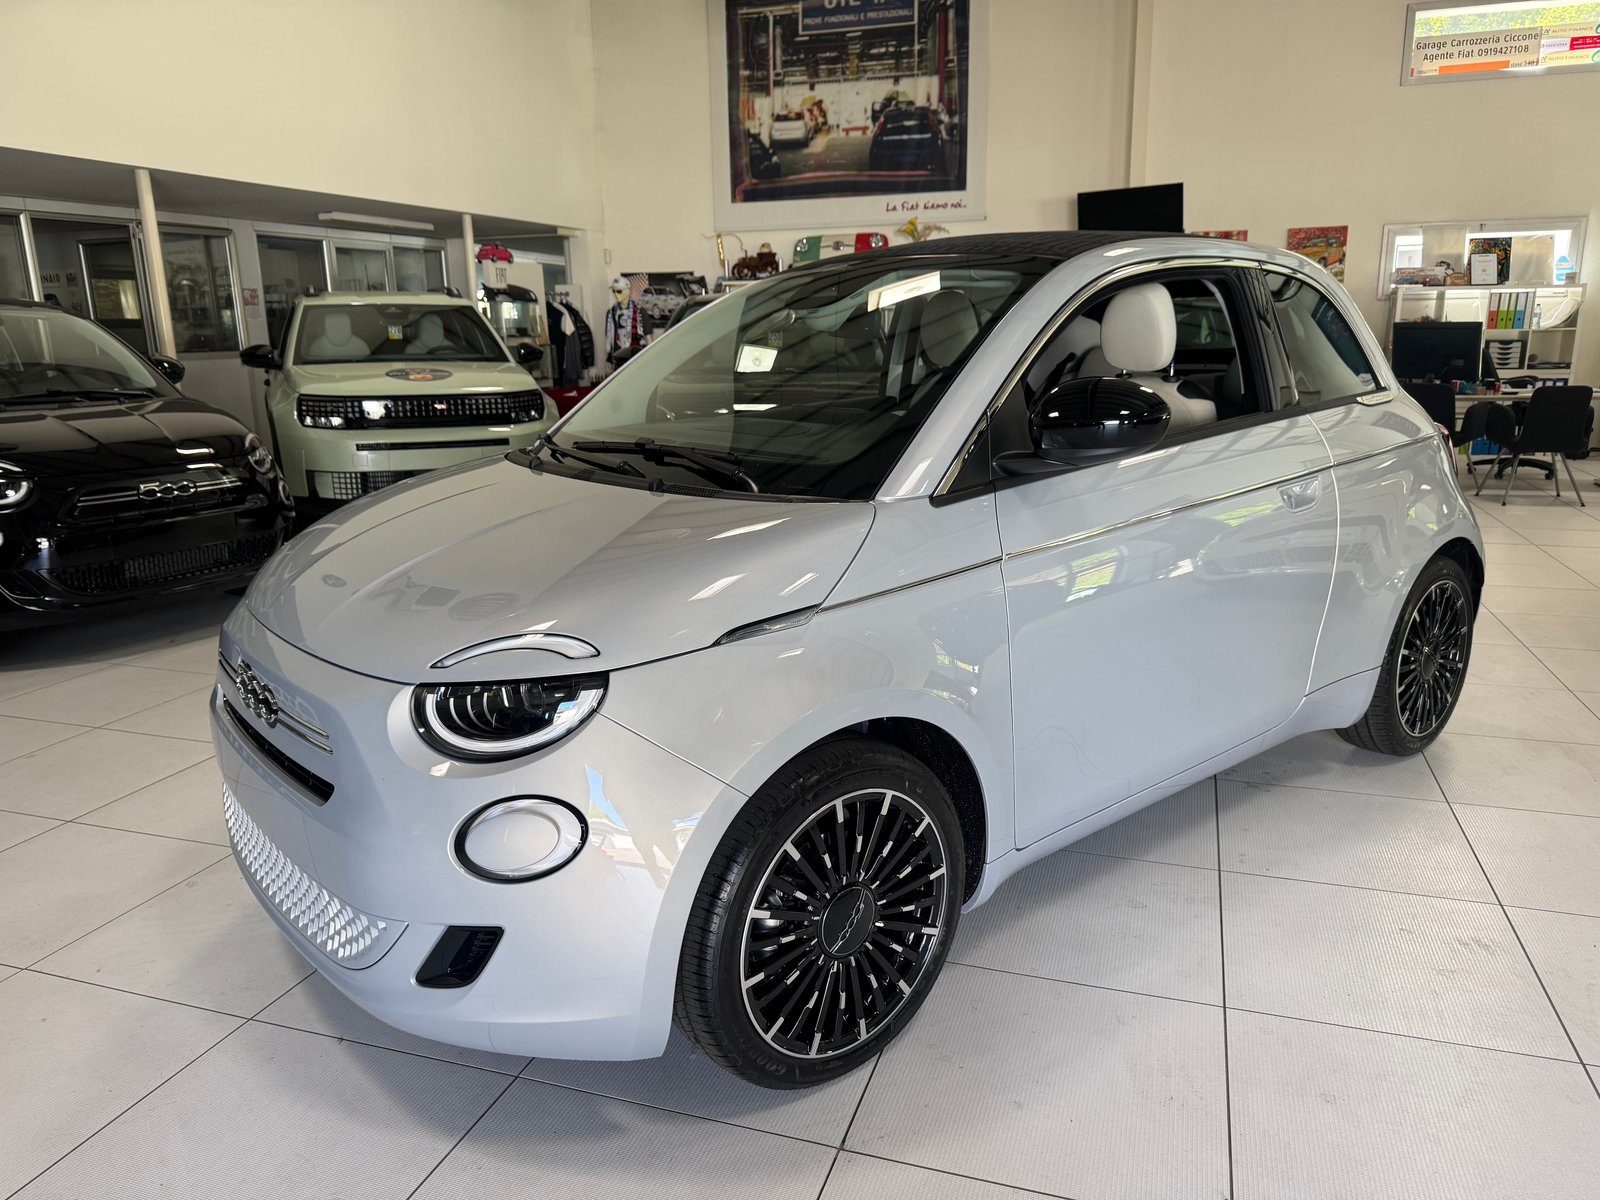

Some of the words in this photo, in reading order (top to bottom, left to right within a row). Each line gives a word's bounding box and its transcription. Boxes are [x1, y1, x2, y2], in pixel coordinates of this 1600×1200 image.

[1416, 40, 1448, 51] Garage
[1450, 35, 1500, 47] Carrozzeria
[1504, 32, 1539, 43] Ciccone
[1422, 52, 1454, 62] Agente
[1457, 49, 1474, 59] Fiat
[1477, 45, 1530, 57] 0919427108
[885, 202, 898, 212] La
[901, 200, 919, 211] Fiat
